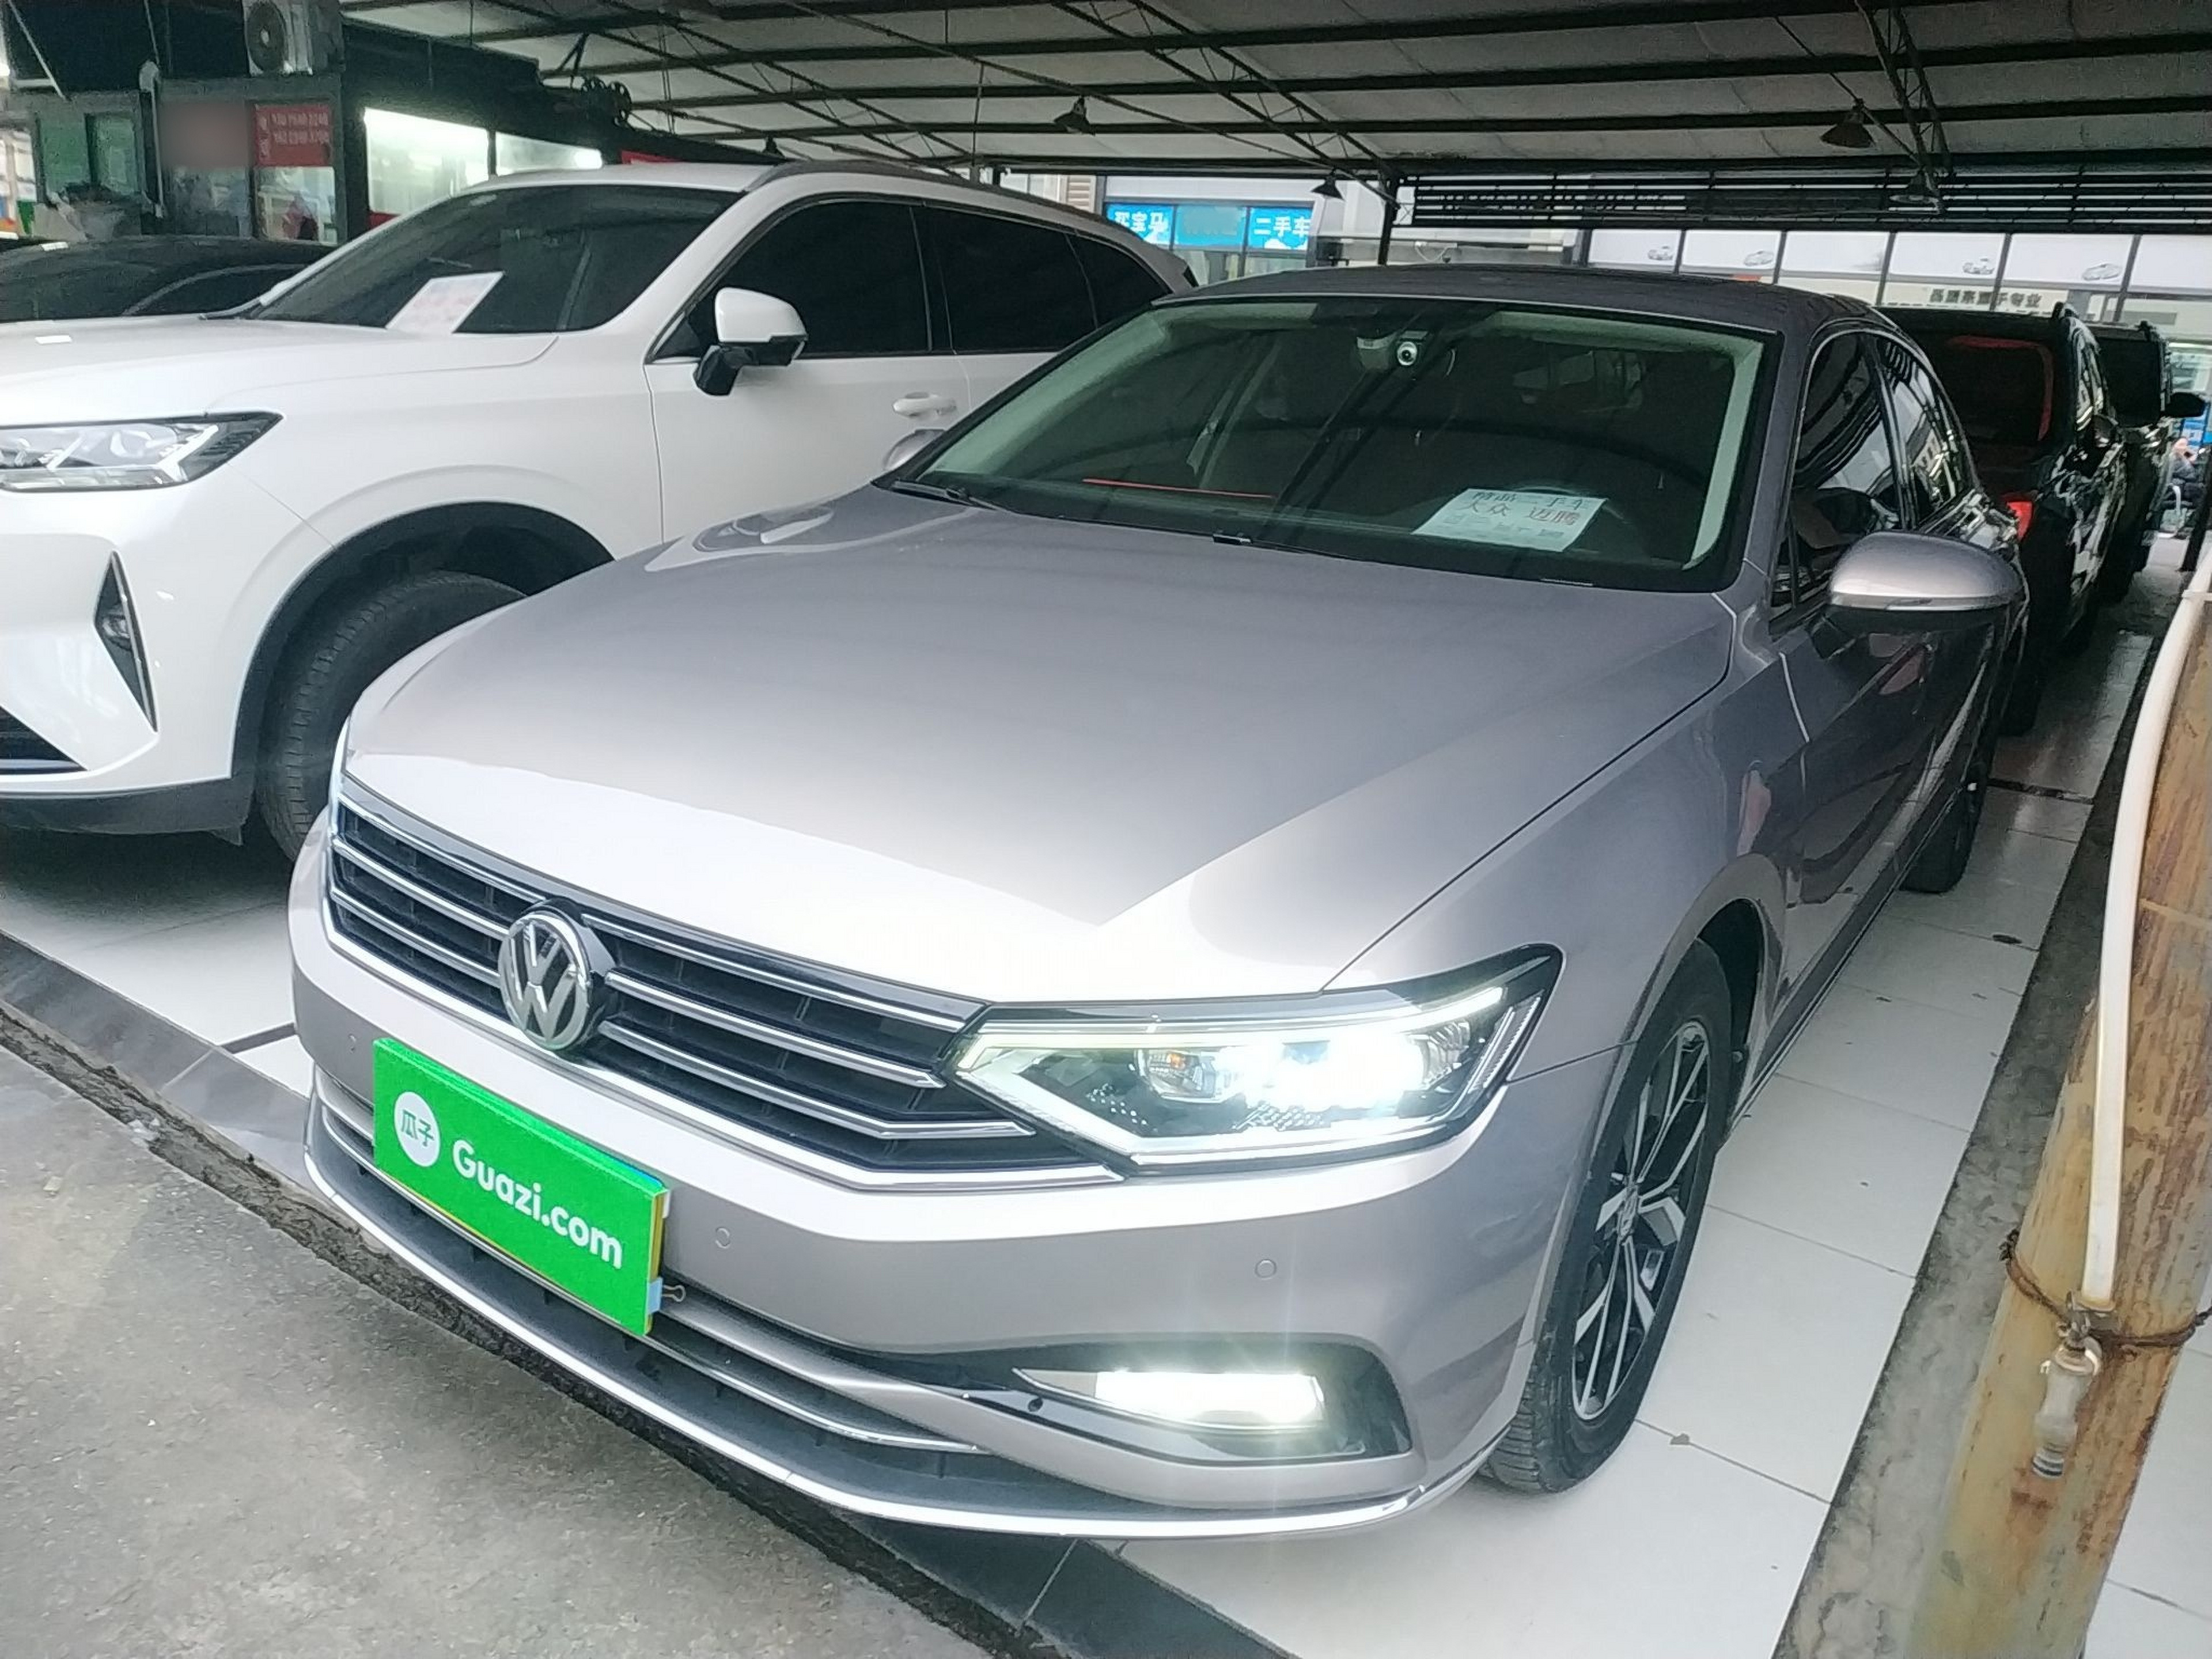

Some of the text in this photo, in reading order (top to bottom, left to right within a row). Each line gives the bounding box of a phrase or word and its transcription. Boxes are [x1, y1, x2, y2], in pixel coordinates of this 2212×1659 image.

[1253, 216, 1312, 238] 二手车
[1456, 500, 1512, 517] 大众
[401, 1109, 435, 1147] 瓜子
[452, 1139, 623, 1270] Guazi.com
